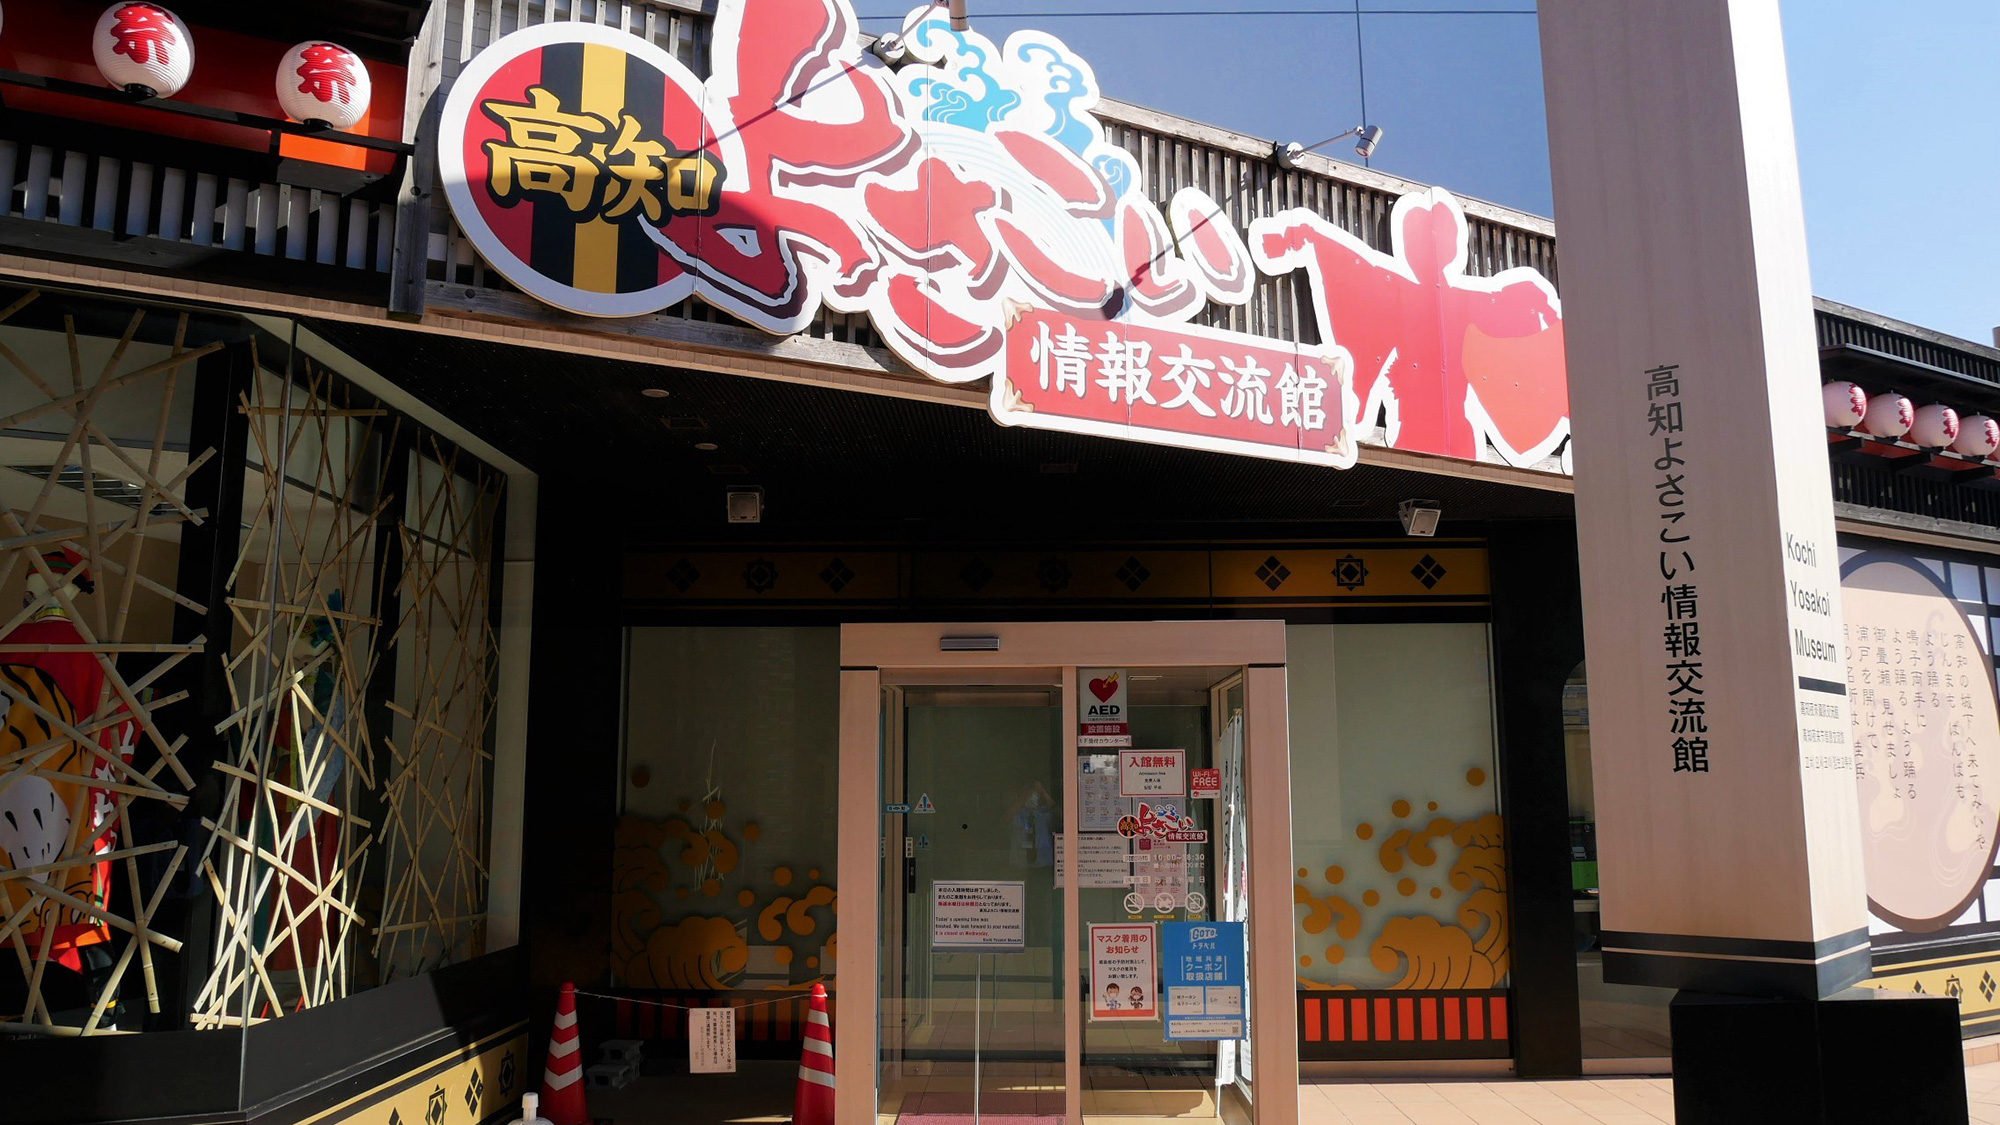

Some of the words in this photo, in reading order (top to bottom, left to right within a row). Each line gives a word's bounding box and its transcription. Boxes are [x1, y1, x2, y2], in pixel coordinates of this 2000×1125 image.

[110, 3, 176, 66] 祭
[296, 43, 357, 105] 祭
[483, 86, 718, 222] 高知
[1030, 320, 1328, 432] 情報交流館
[1786, 532, 1817, 568] Kochi
[1644, 364, 1709, 773] 高知よさこい情報交流館
[1790, 580, 1831, 617] Yosakoi
[1795, 628, 1837, 664] Museum
[1088, 705, 1120, 715] AED
[1129, 756, 1176, 768] 入館無料
[1192, 777, 1218, 786] FREE
[1096, 934, 1148, 943] マスク着用の
[1106, 945, 1139, 954] お知らせ
[1192, 942, 1216, 950] トラベル
[1185, 963, 1223, 972] クーポン
[1185, 972, 1223, 981] 取扱店舗
